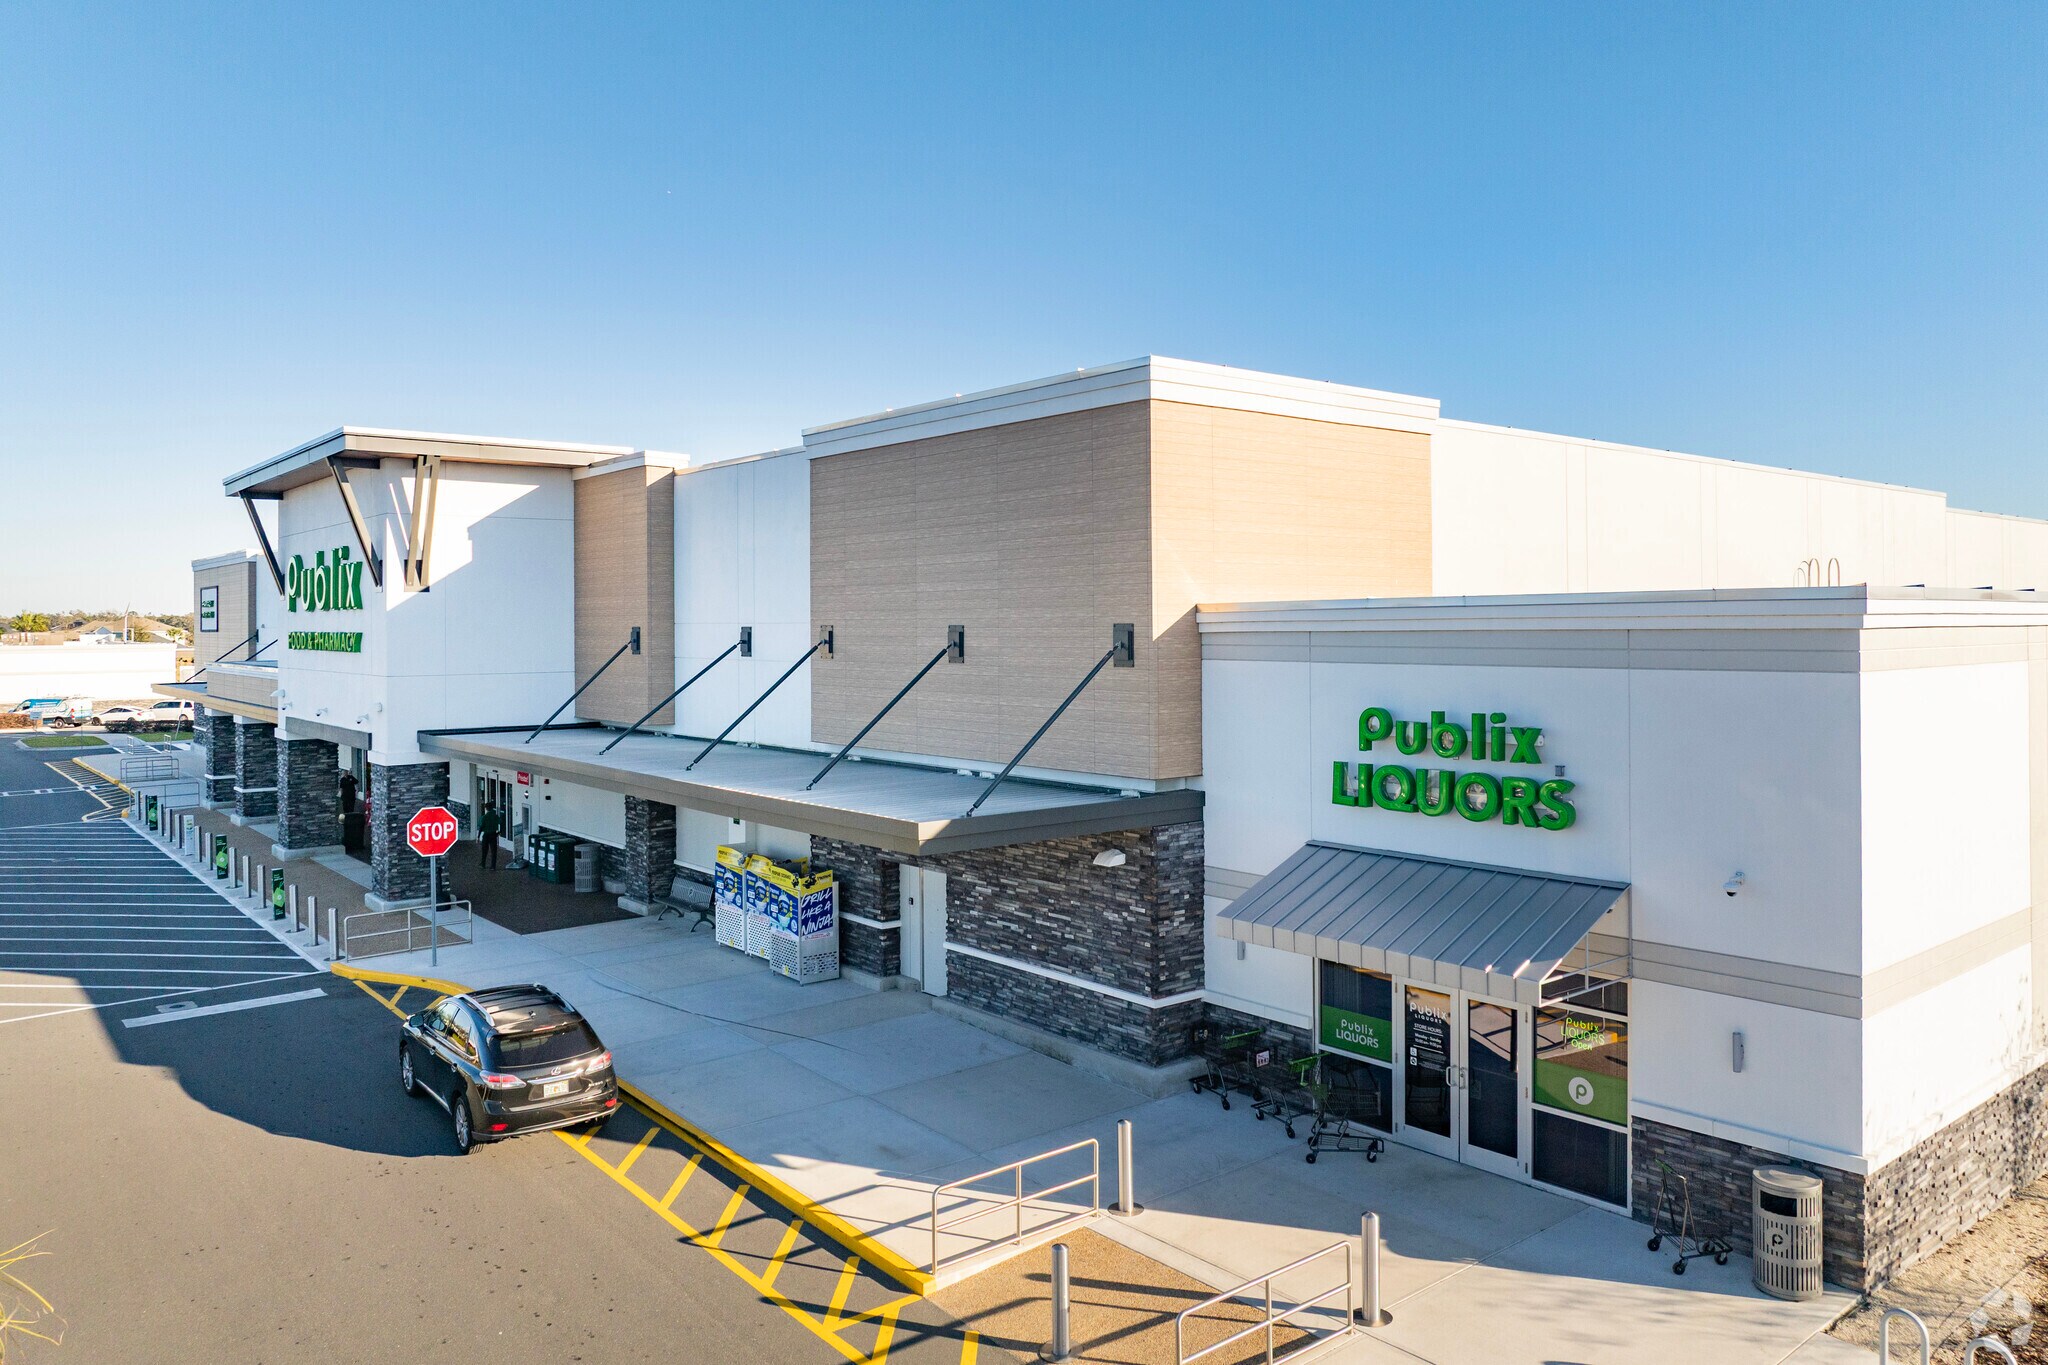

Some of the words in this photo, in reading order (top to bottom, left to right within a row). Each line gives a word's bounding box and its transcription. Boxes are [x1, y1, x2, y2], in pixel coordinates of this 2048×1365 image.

[287, 546, 363, 612] Publix
[314, 632, 362, 653] PHARMACY
[1358, 707, 1542, 764] Publix
[1332, 761, 1577, 830] LIQUORS
[411, 821, 454, 842] STOP
[801, 888, 833, 907] GRILL
[801, 904, 823, 919] LIKE
[824, 901, 832, 911] A
[1409, 1002, 1447, 1020] Publix
[1414, 1013, 1442, 1024] LIQUORS
[1341, 1019, 1374, 1036] Publix
[1566, 1017, 1599, 1033] Publix
[1336, 1028, 1379, 1048] LIQUORS
[1561, 1026, 1605, 1045] LIQUORS
[1571, 1039, 1593, 1050] Open
